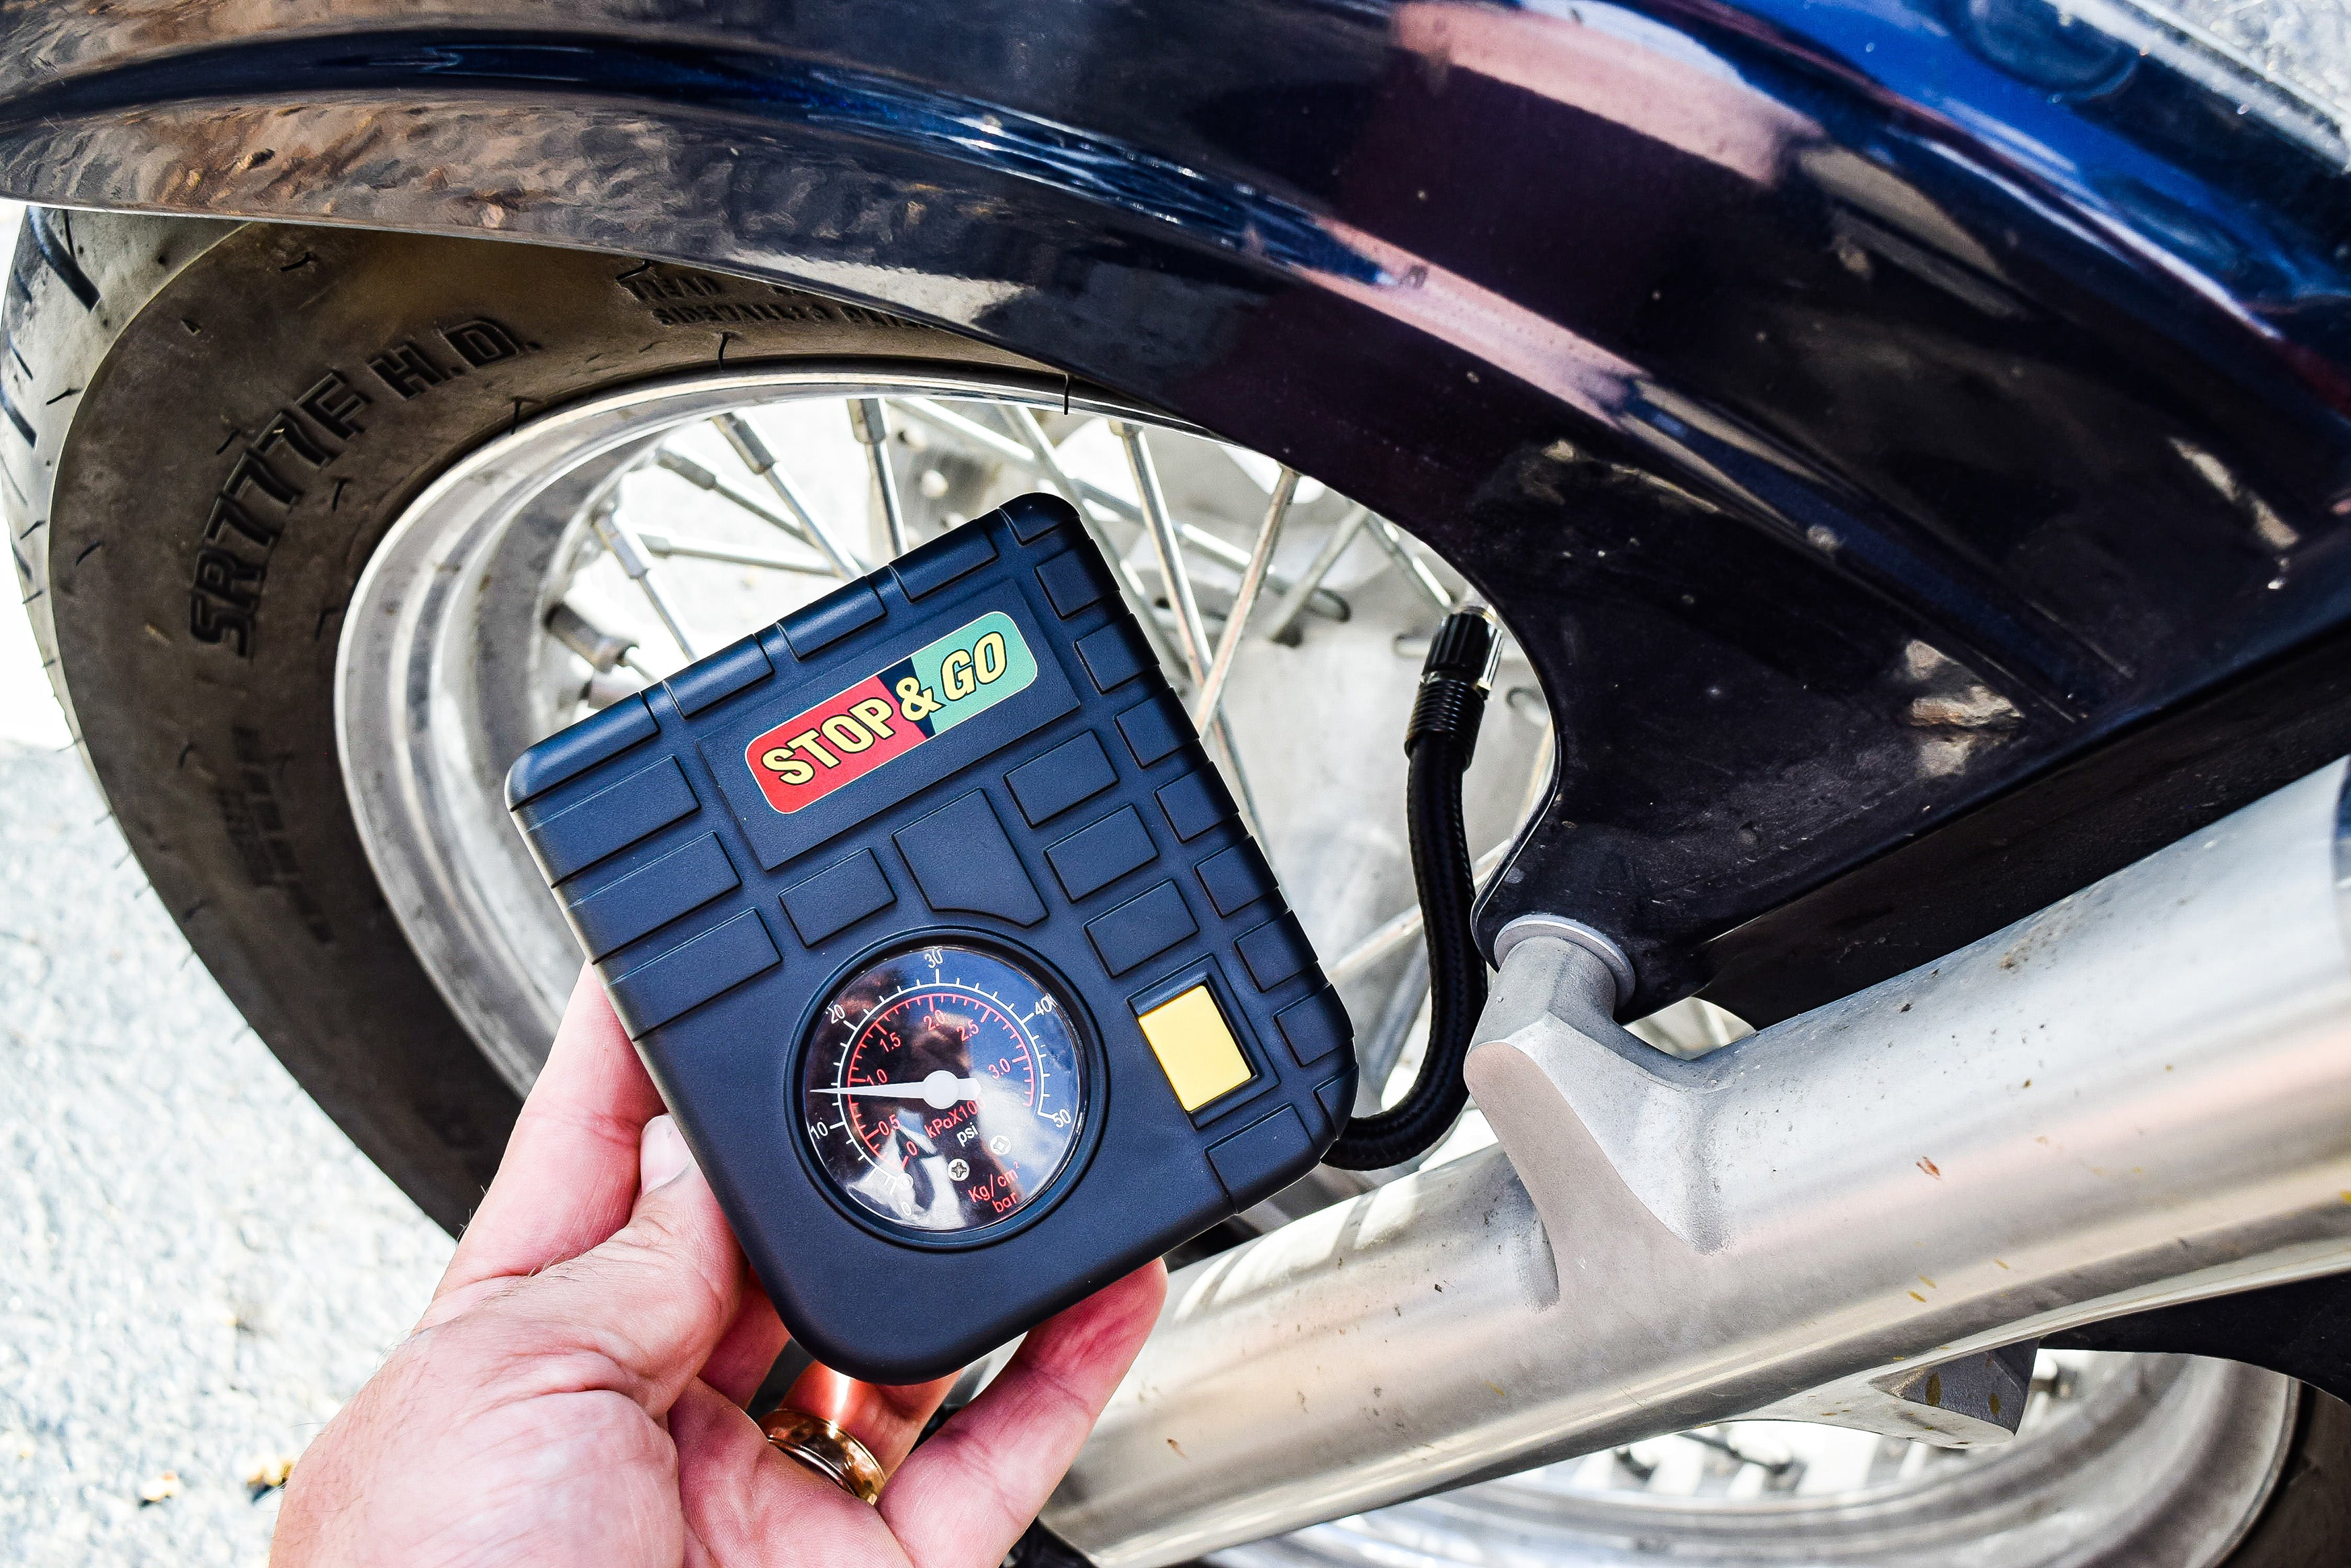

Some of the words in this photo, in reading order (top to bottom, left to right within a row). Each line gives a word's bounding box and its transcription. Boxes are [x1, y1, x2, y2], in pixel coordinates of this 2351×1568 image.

[762, 696, 895, 785] STOP
[895, 676, 945, 722] &
[940, 631, 1008, 701] GO
[924, 948, 943, 968] 30
[828, 1003, 846, 1024] 20
[1034, 997, 1053, 1015] 40
[923, 1008, 946, 1032] 2.0
[956, 1019, 980, 1042] 2.5
[879, 1031, 901, 1053] 1.5
[867, 1068, 888, 1086] 1.0
[988, 1058, 1012, 1080] 3.0
[878, 1113, 901, 1136] 0.5
[1053, 1108, 1072, 1129] 50
[809, 1121, 829, 1140] 10
[957, 1121, 979, 1148] psi
[906, 1140, 919, 1156] 0
[991, 1191, 1018, 1213] bar
